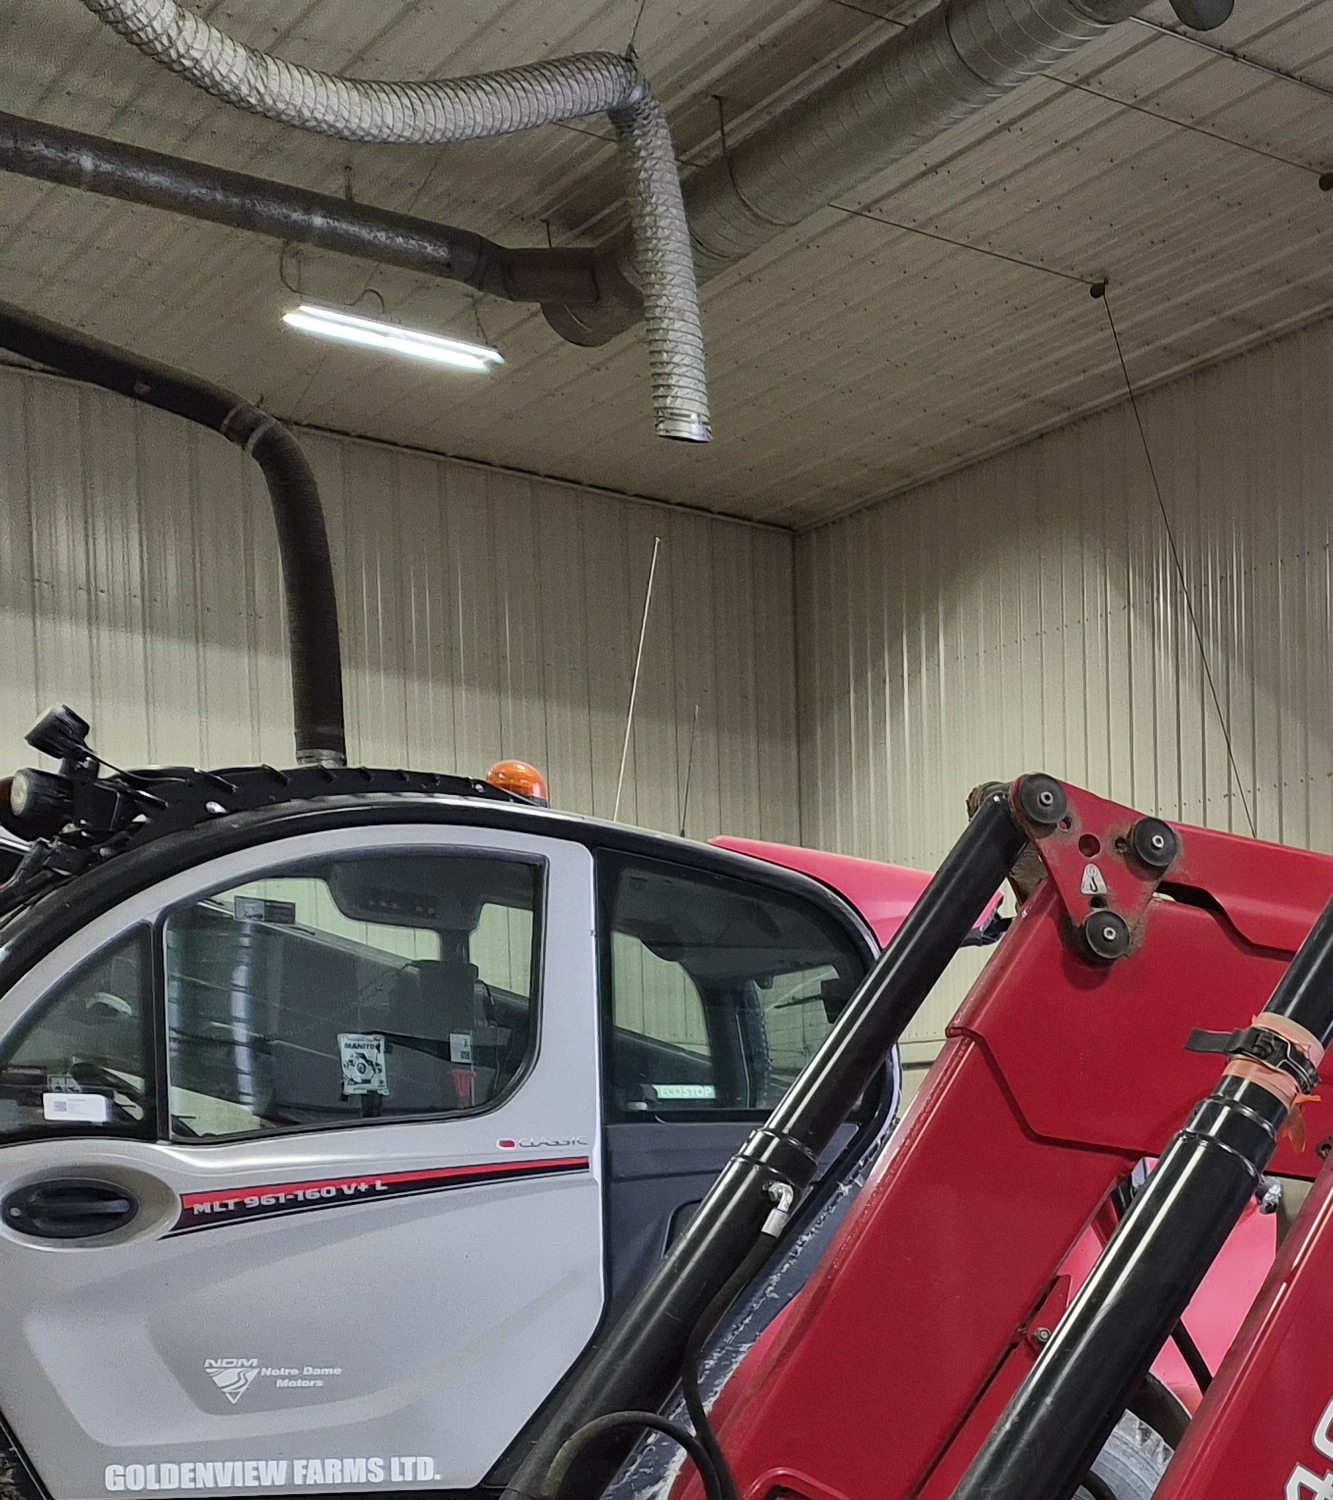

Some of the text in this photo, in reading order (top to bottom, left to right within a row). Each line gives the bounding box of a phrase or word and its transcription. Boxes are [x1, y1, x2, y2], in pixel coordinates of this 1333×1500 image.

[660, 1085, 713, 1098] ECOSTOP
[518, 1135, 589, 1149] CLASSIC
[193, 1178, 389, 1216] MLT 961-160 V+ L
[204, 1358, 259, 1368] NDM
[260, 1366, 343, 1377] Notre Dame
[275, 1378, 324, 1388] Motors
[104, 1456, 441, 1492] GOLDENVIEW FARMS LTD.
